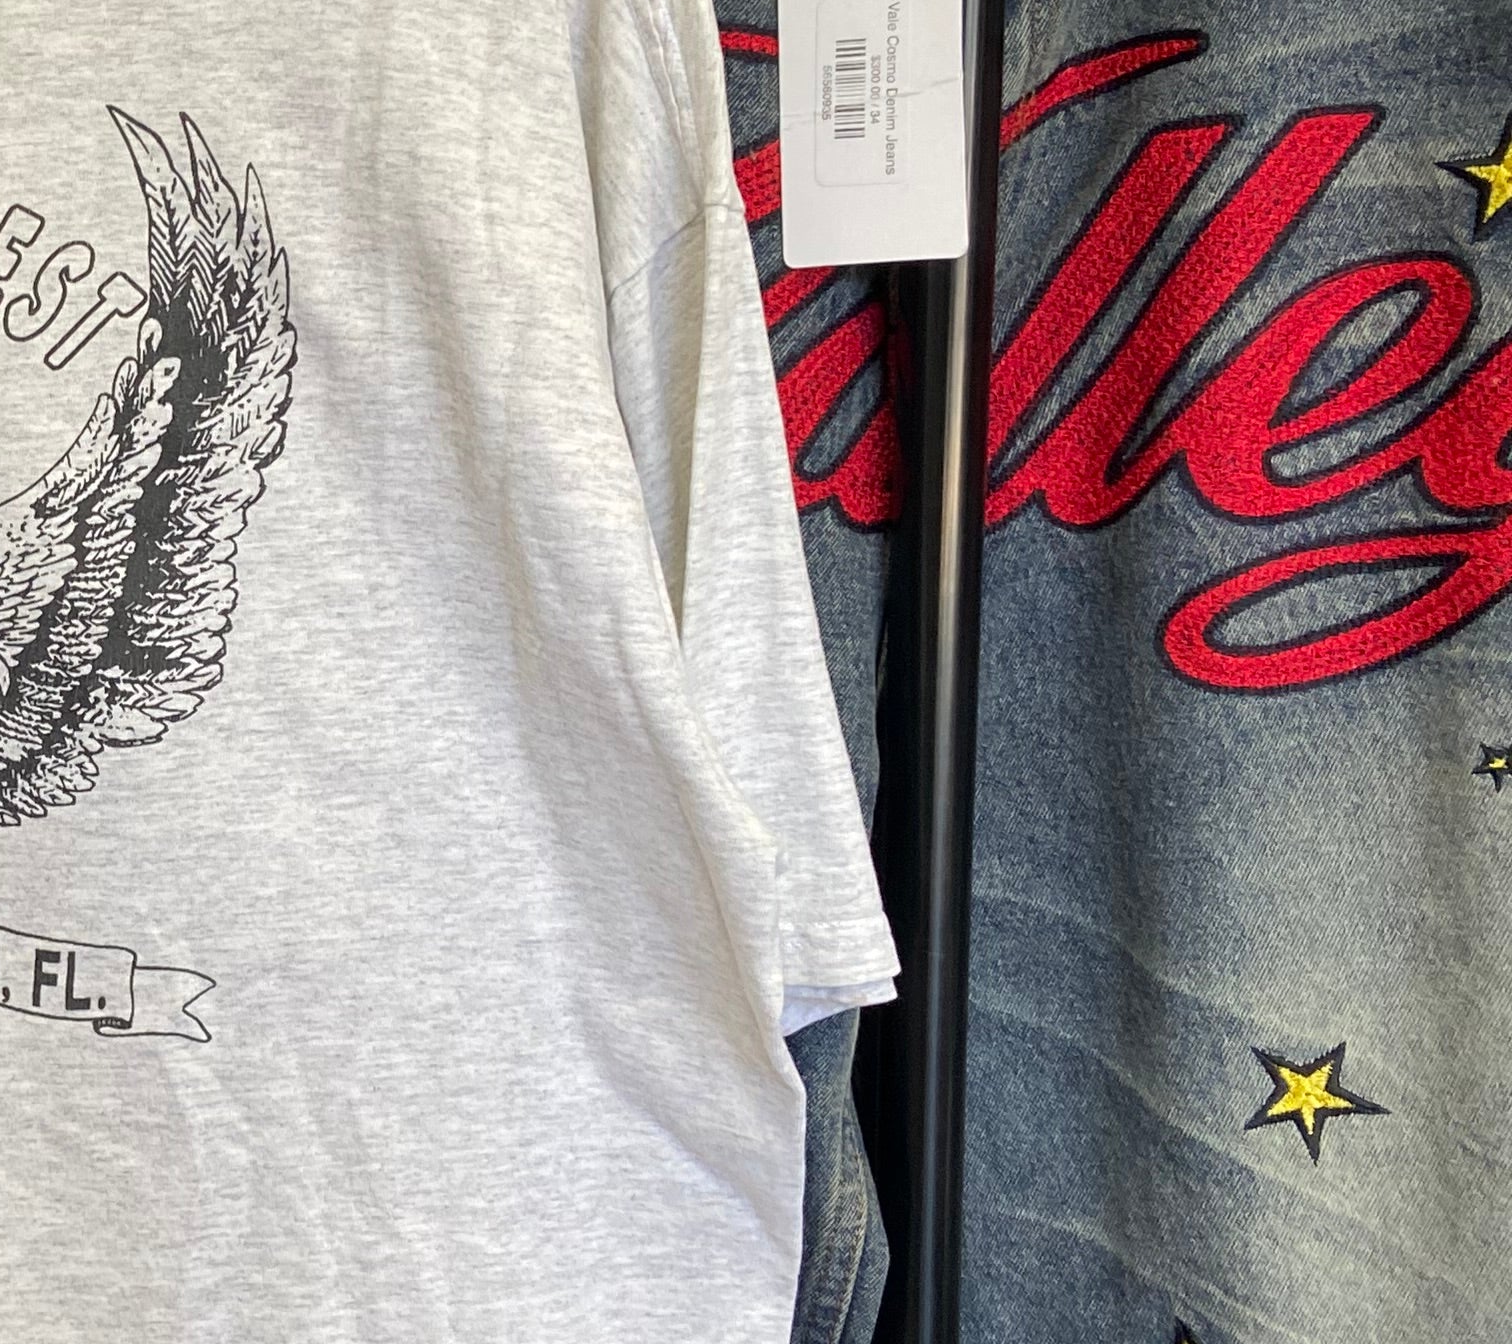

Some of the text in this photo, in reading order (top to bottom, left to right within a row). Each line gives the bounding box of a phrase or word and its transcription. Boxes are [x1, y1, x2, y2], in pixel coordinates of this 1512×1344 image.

[870, 54, 881, 100] $30000
[885, 1, 900, 176] Vale Cosmo Denim Jeans
[870, 109, 881, 125] 34
[30, 948, 108, 1012] FL.
